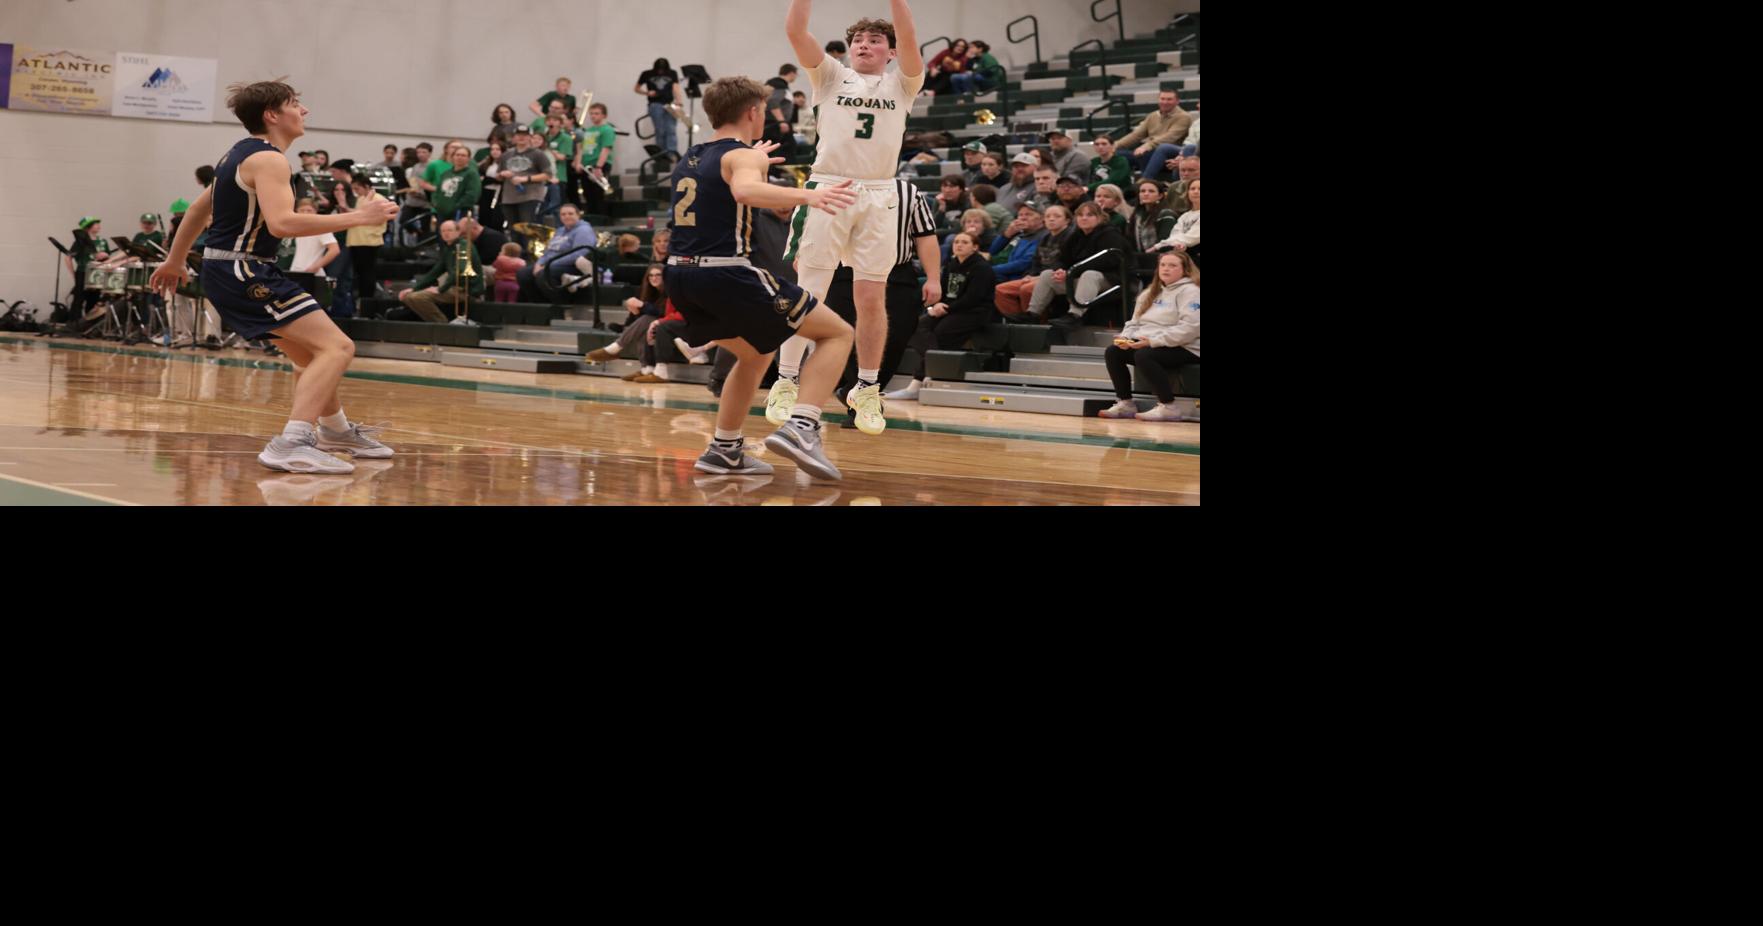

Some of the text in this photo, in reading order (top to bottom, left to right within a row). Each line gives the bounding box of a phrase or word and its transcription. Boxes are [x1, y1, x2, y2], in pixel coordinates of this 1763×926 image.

[17, 58, 111, 73] ATLANTIC
[836, 95, 896, 111] TROJANS
[854, 112, 875, 139] 3
[674, 177, 697, 226] 2
